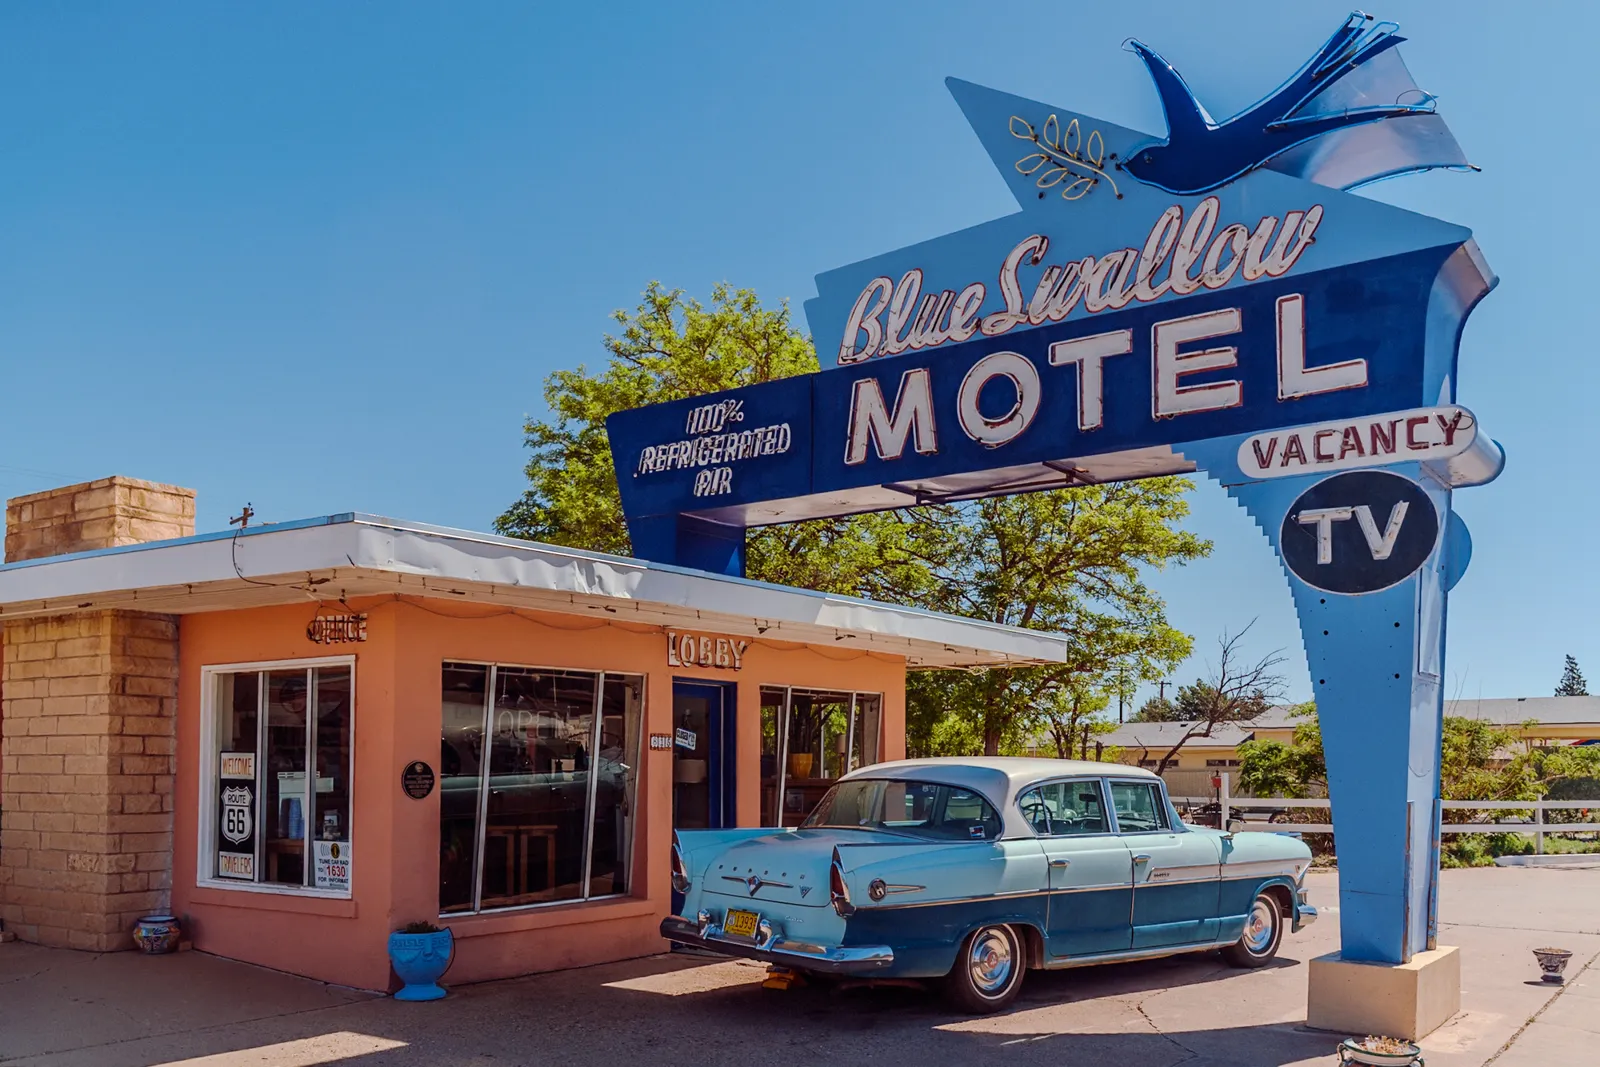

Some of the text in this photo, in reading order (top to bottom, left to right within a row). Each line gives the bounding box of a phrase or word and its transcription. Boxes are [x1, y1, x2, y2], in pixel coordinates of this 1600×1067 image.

[837, 196, 1324, 366] Blue Swallow
[843, 292, 1369, 467] MOTEL
[638, 423, 791, 475] REFRIGERATED
[1252, 407, 1472, 468] VACANCY
[693, 466, 733, 497] AIR
[1296, 500, 1409, 565] TV
[667, 632, 746, 671] LOBBY
[222, 757, 252, 775] WELCOME
[227, 794, 247, 804] ROUTE
[227, 808, 245, 834] 66
[220, 855, 252, 875] TRAVELERS
[326, 865, 346, 877] 1630
[735, 915, 754, 930] 1393
